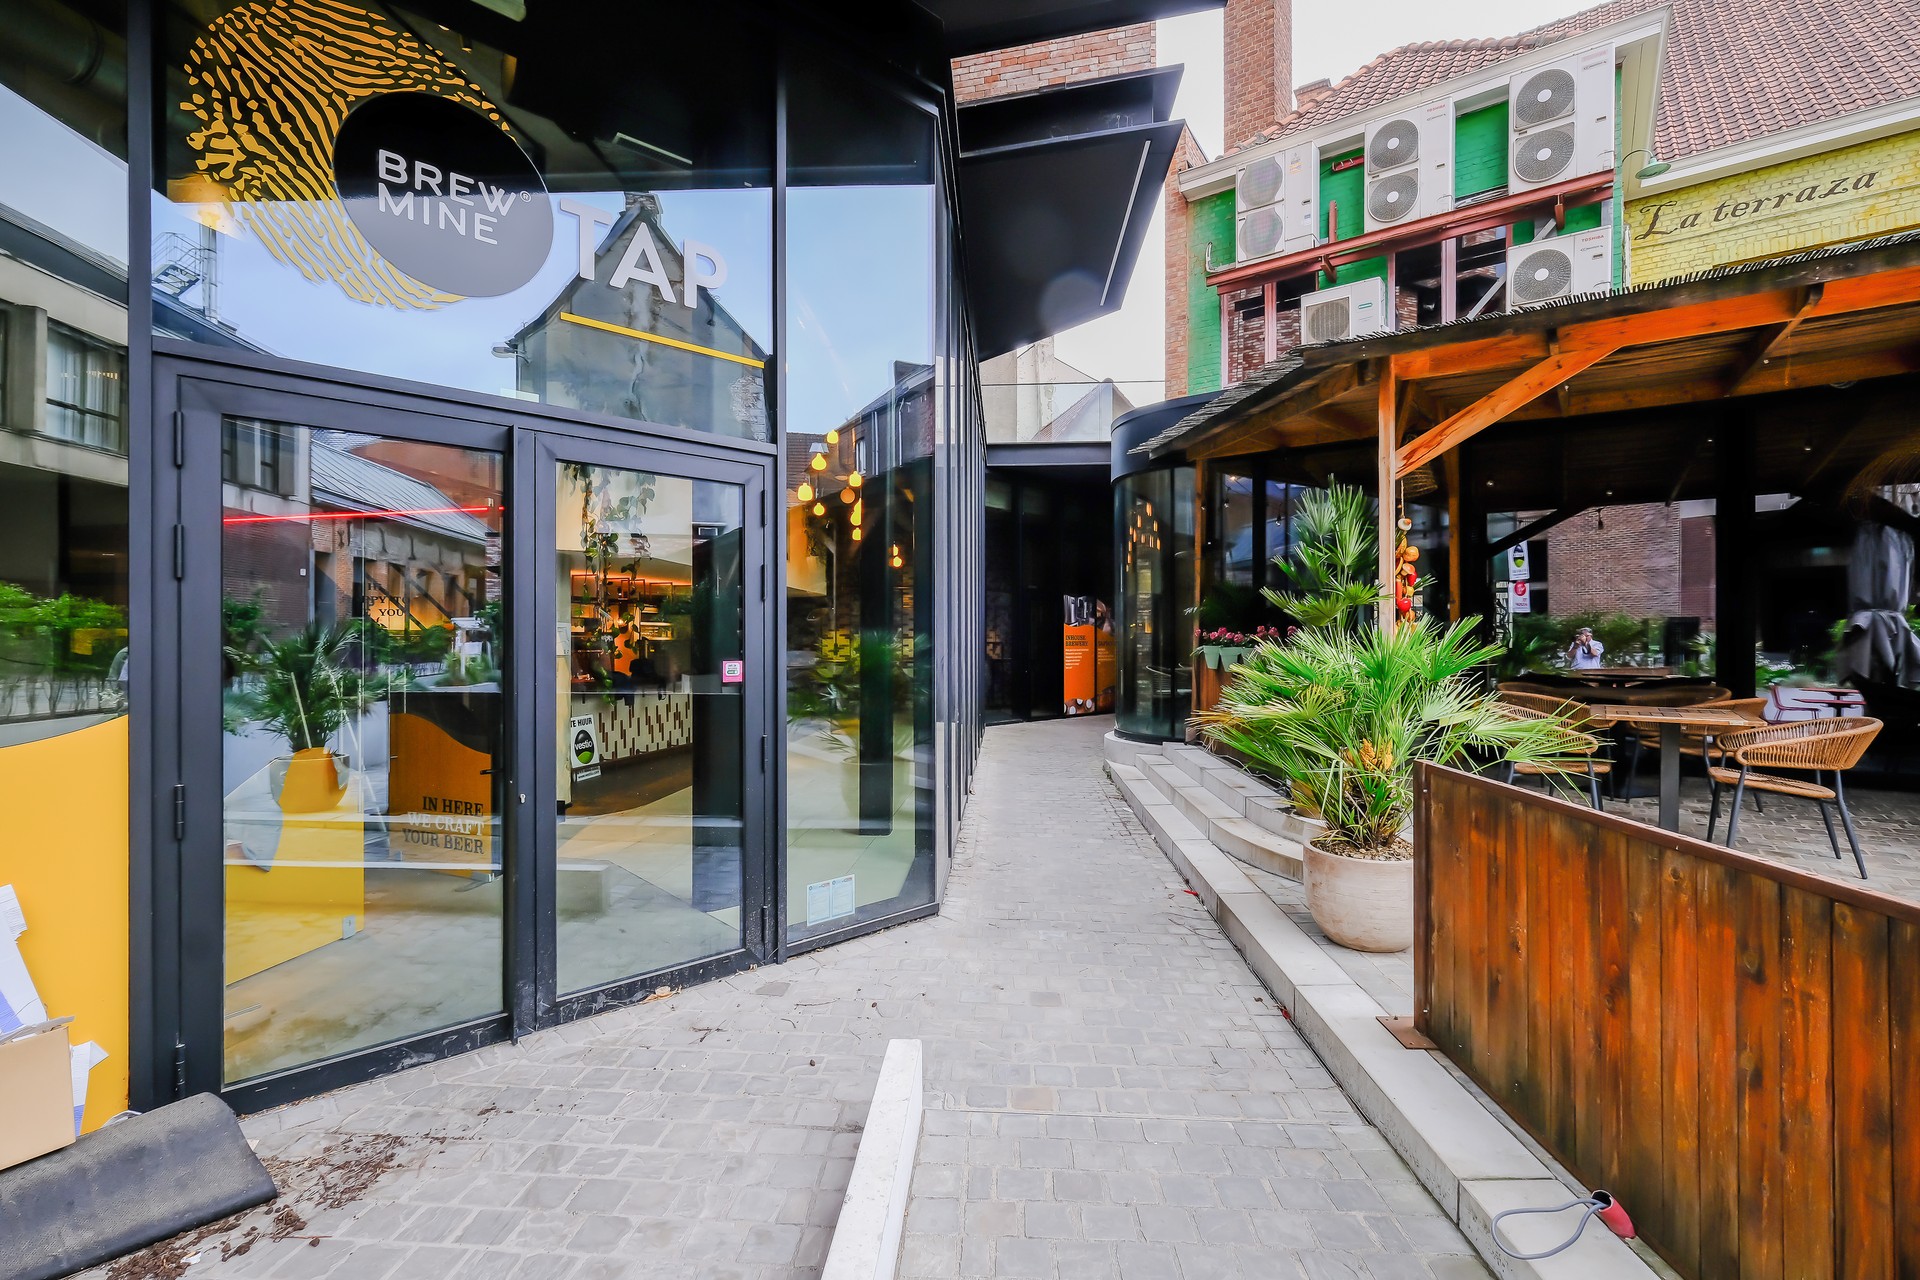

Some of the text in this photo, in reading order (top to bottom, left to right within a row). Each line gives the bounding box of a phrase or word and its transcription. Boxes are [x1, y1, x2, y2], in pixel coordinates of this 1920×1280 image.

[378, 182, 498, 245] MINE
[1634, 171, 1879, 240] La terraza
[560, 198, 728, 309] TAP
[578, 718, 592, 726] HUUR
[575, 740, 592, 750] vestio
[422, 796, 484, 817] IN HERE
[407, 812, 484, 836] WE CRAFT
[402, 828, 484, 854] YOUR BEER
